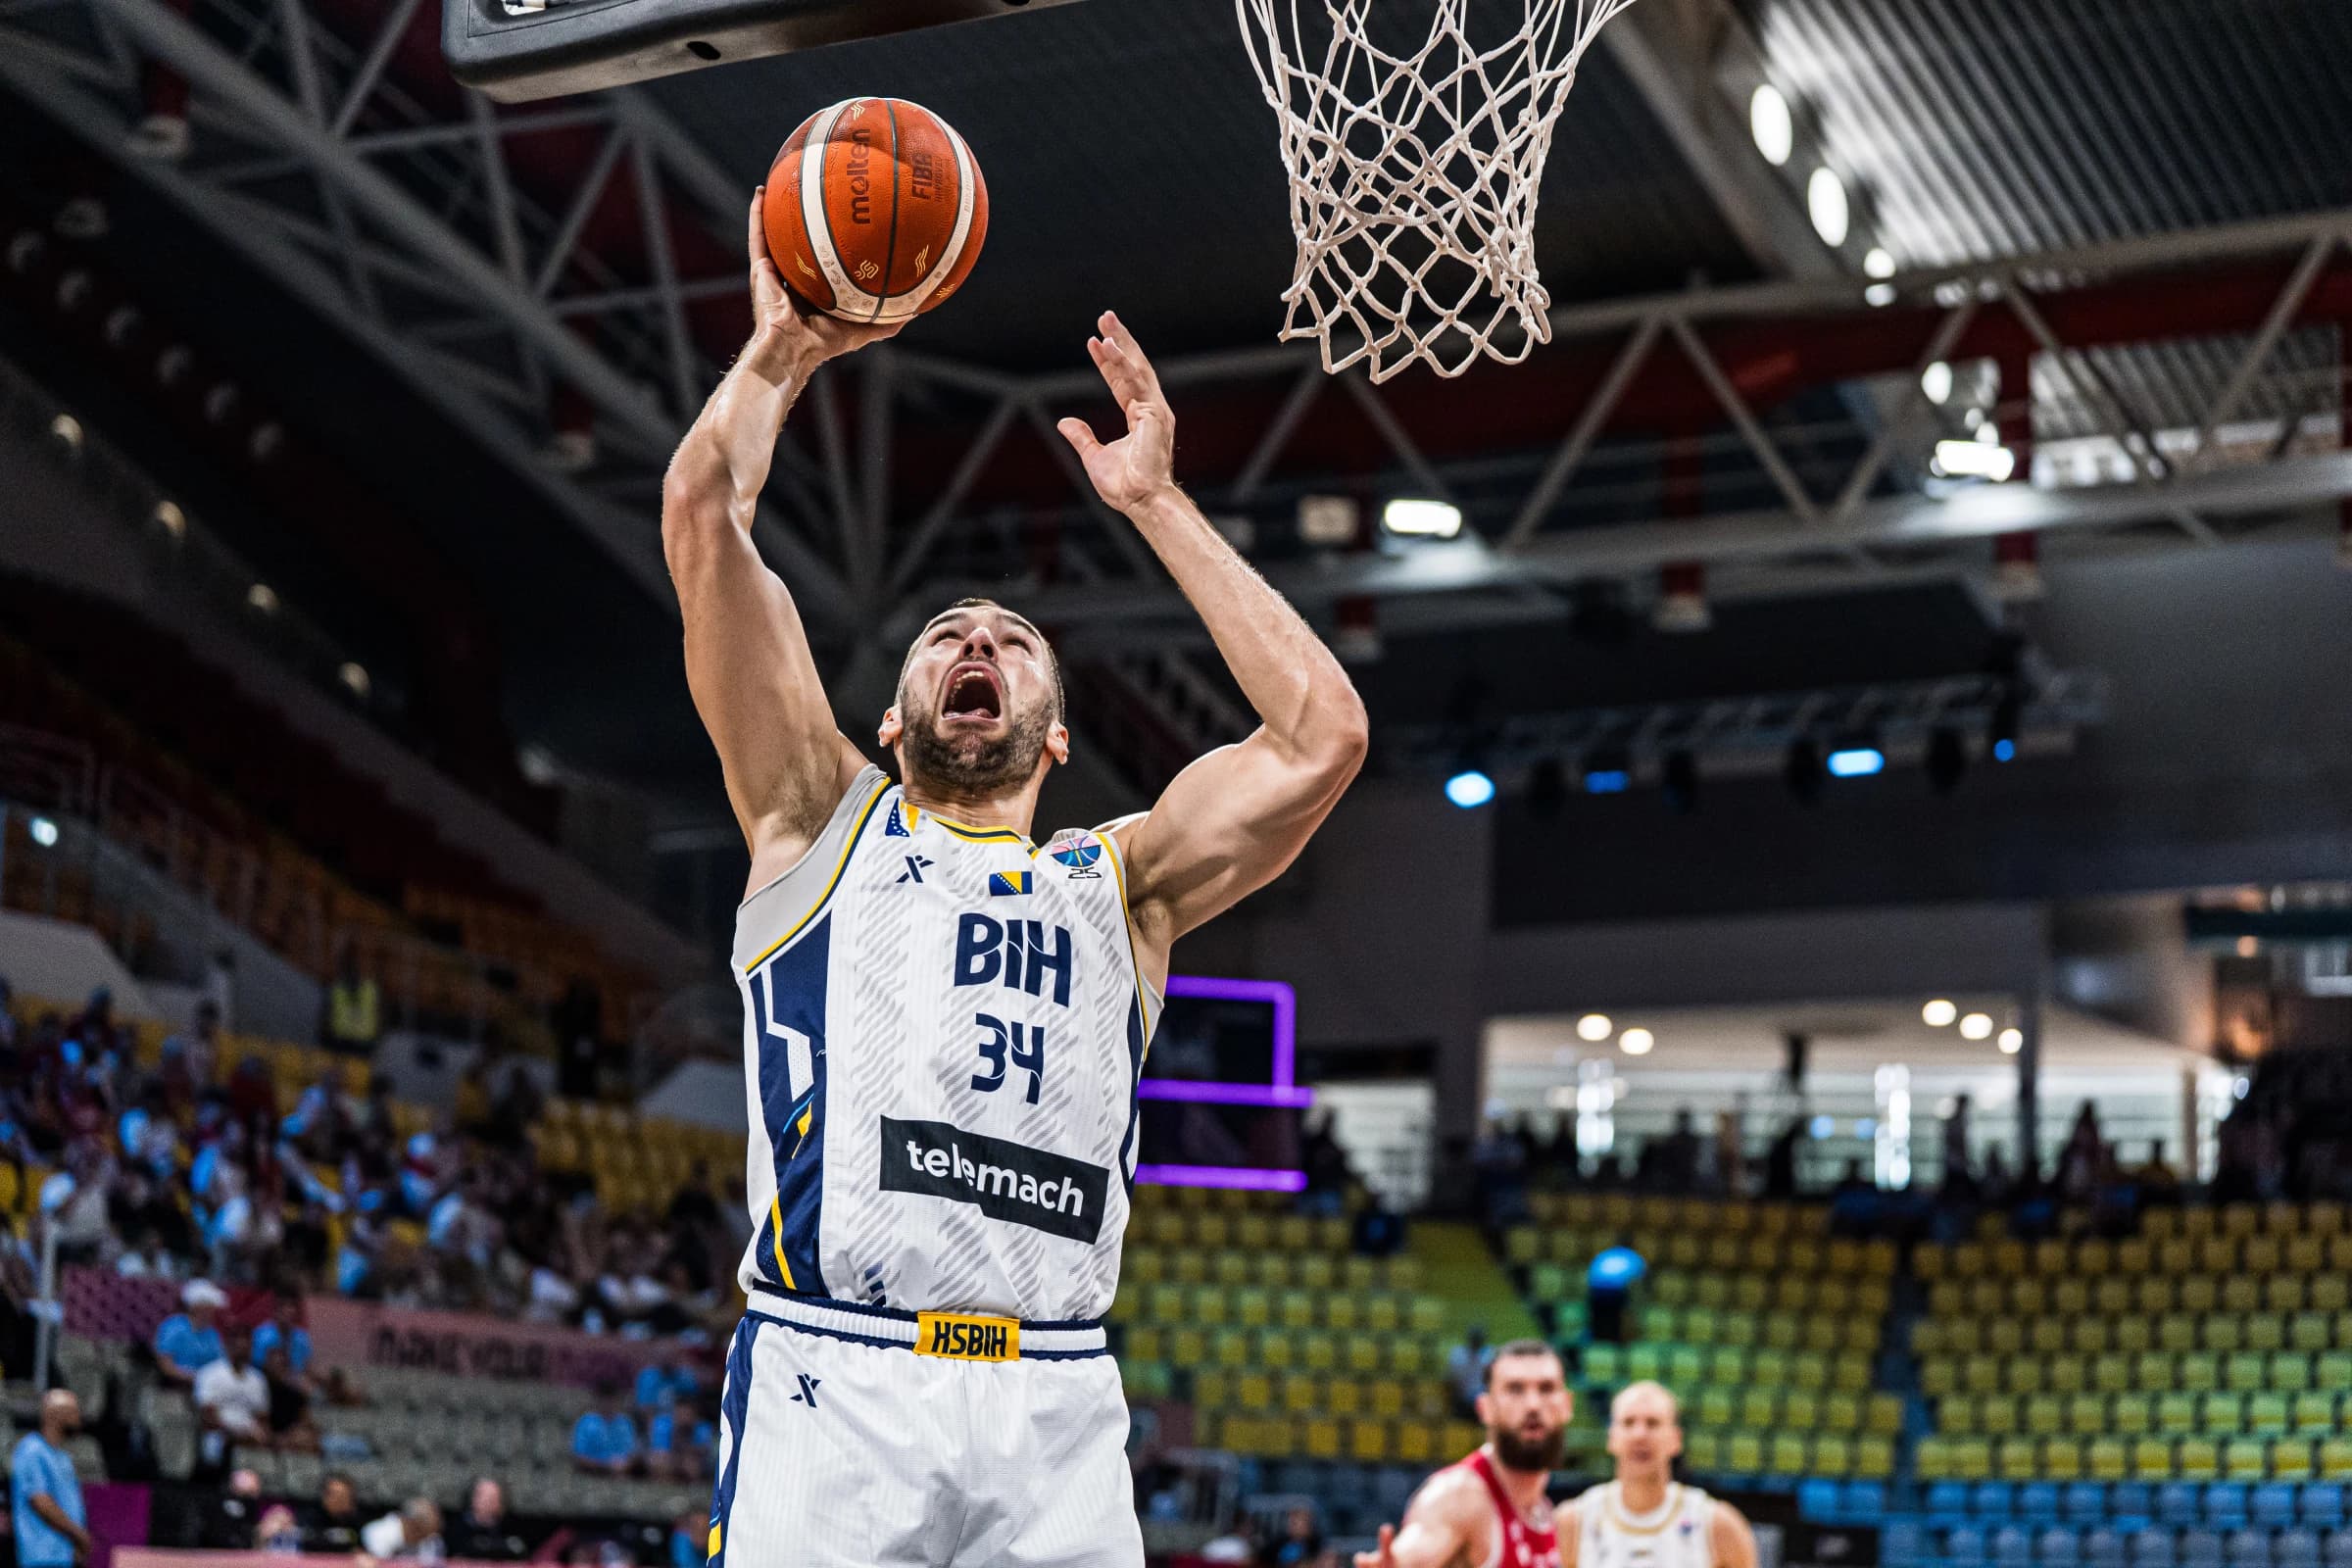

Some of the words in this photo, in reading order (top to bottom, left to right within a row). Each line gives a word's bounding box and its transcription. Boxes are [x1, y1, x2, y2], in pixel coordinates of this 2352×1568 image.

[847, 128, 870, 224] molten
[911, 153, 933, 200] FIBA
[1068, 866, 1102, 879] 25
[954, 912, 1072, 1008] BIH
[970, 1012, 1045, 1104] 34
[906, 1140, 1084, 1217] telemach
